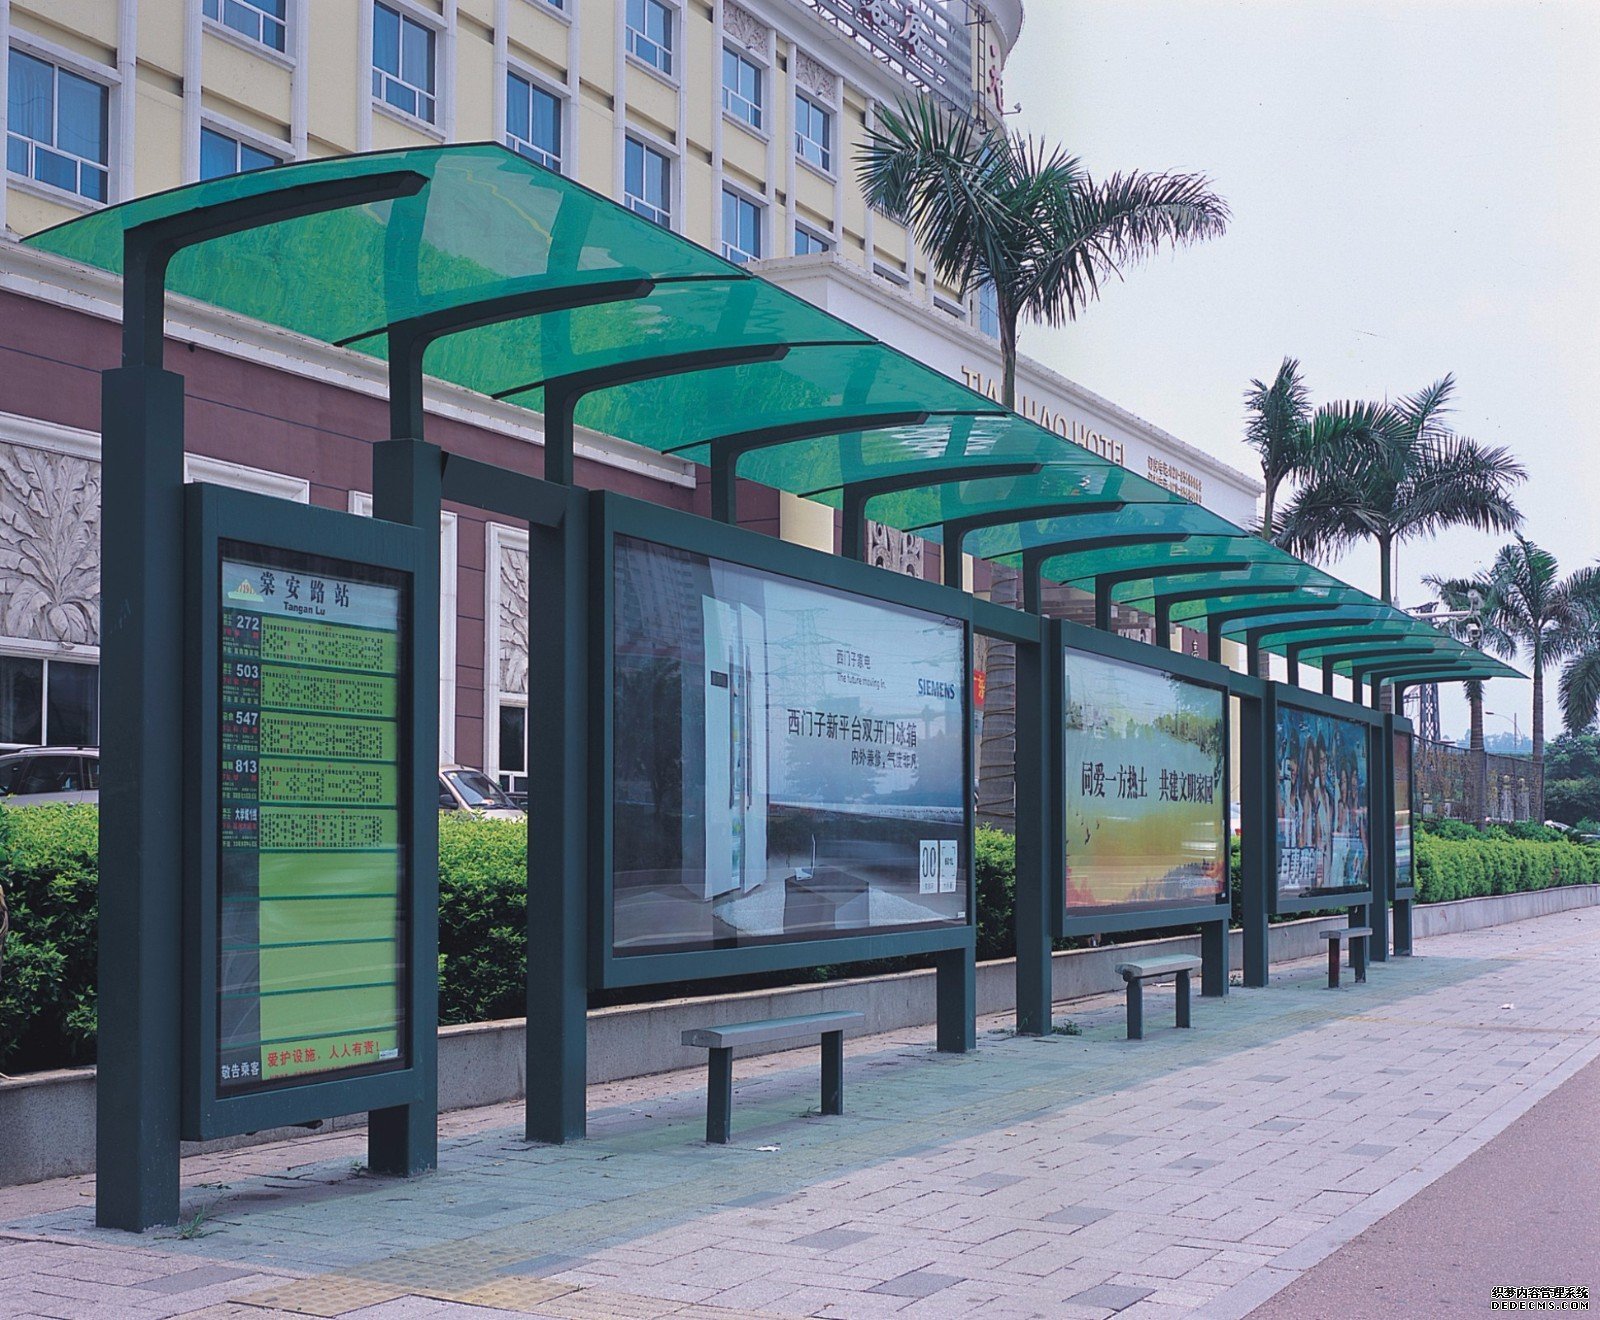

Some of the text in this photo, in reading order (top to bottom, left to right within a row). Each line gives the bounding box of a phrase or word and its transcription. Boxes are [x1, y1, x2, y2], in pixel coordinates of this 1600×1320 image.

[260, 571, 349, 608] 棠安路站
[283, 601, 326, 616] Tangan Lu
[237, 615, 259, 631] 272
[236, 663, 259, 679] 503
[917, 678, 956, 700] SIEMENS
[235, 711, 258, 726] 547
[787, 708, 917, 748] 西门子新平台双开门冰箱
[235, 760, 257, 773] 813
[1158, 768, 1214, 805] 共建文明家园
[221, 1061, 259, 1079] 敬告乘客
